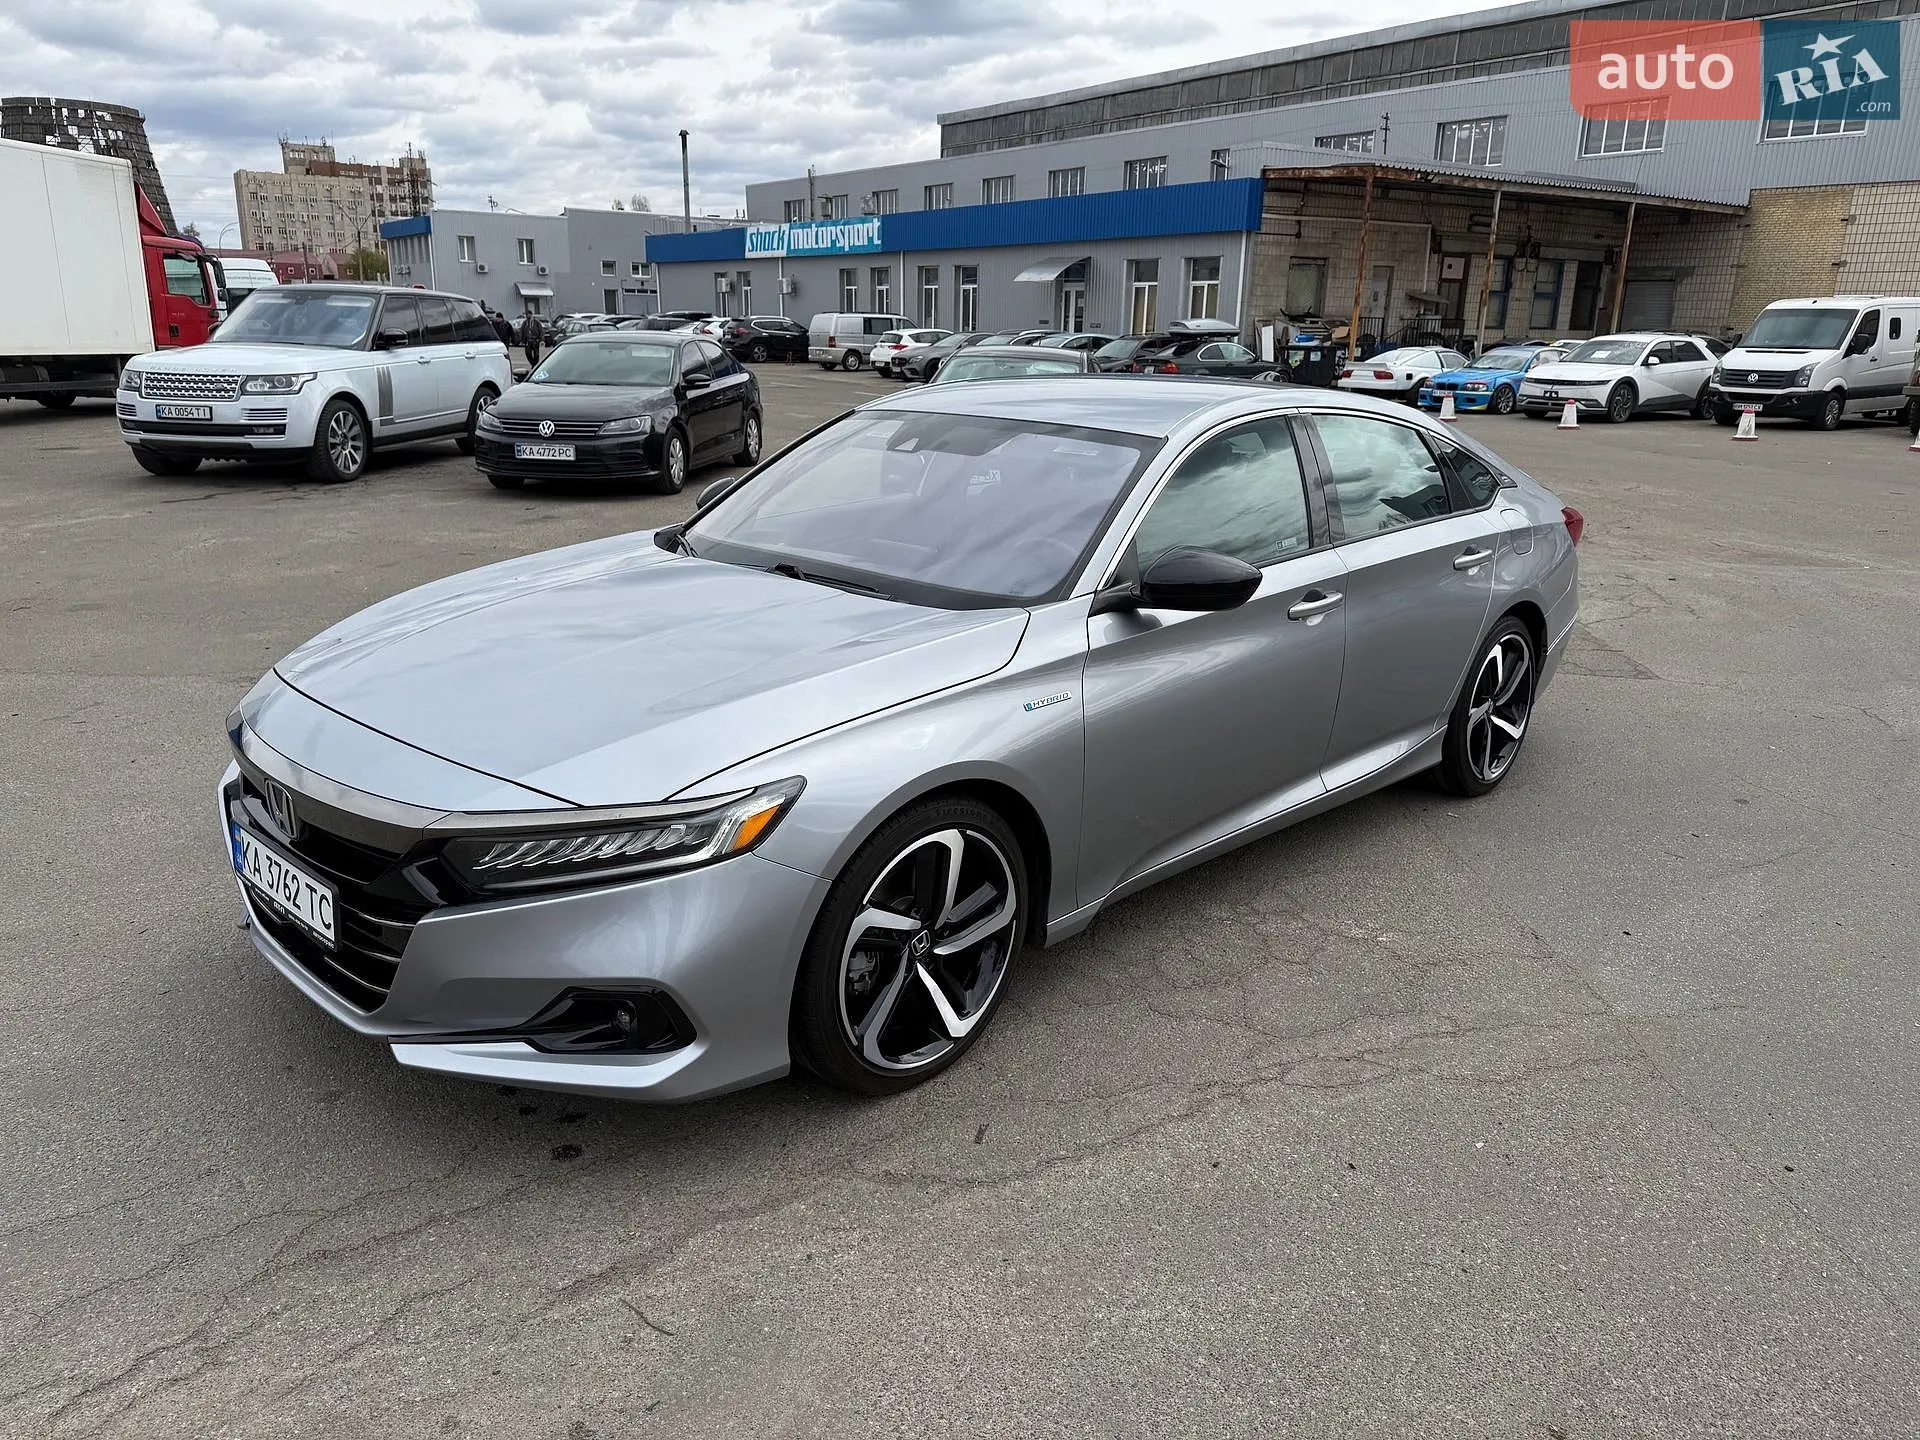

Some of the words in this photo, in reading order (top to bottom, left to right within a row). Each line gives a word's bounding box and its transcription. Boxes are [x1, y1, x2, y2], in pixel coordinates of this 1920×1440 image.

[747, 225, 786, 253] shock
[790, 218, 882, 251] motorsport
[536, 448, 557, 458] 4772
[558, 449, 572, 458] PC
[1033, 692, 1069, 707] HYBRID
[242, 835, 263, 883] KA
[265, 853, 302, 912] 3762
[305, 881, 333, 930] TC
